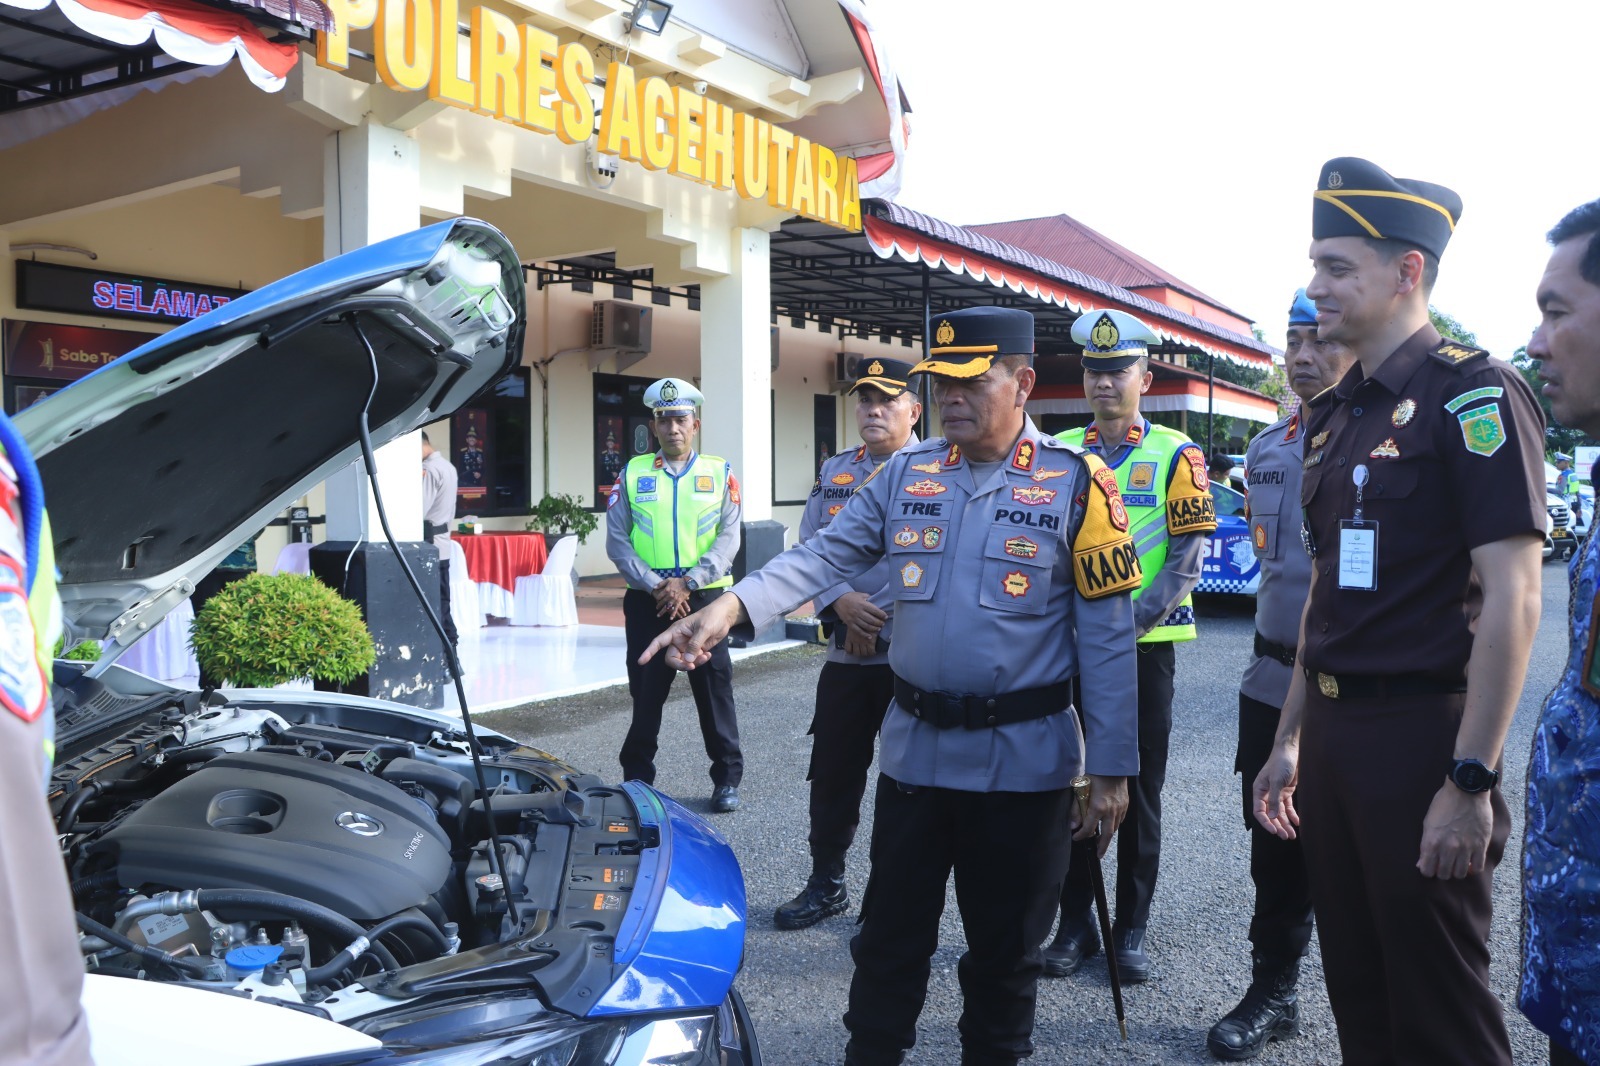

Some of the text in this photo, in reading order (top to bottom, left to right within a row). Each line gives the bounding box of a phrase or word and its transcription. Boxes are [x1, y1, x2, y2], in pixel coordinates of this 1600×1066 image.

[316, 0, 863, 233] POLRES ACEH UTARA
[60, 348, 99, 363] Sabe
[1123, 496, 1155, 505] POLRI
[902, 502, 942, 516] TRIE
[995, 509, 1059, 531] POLRI
